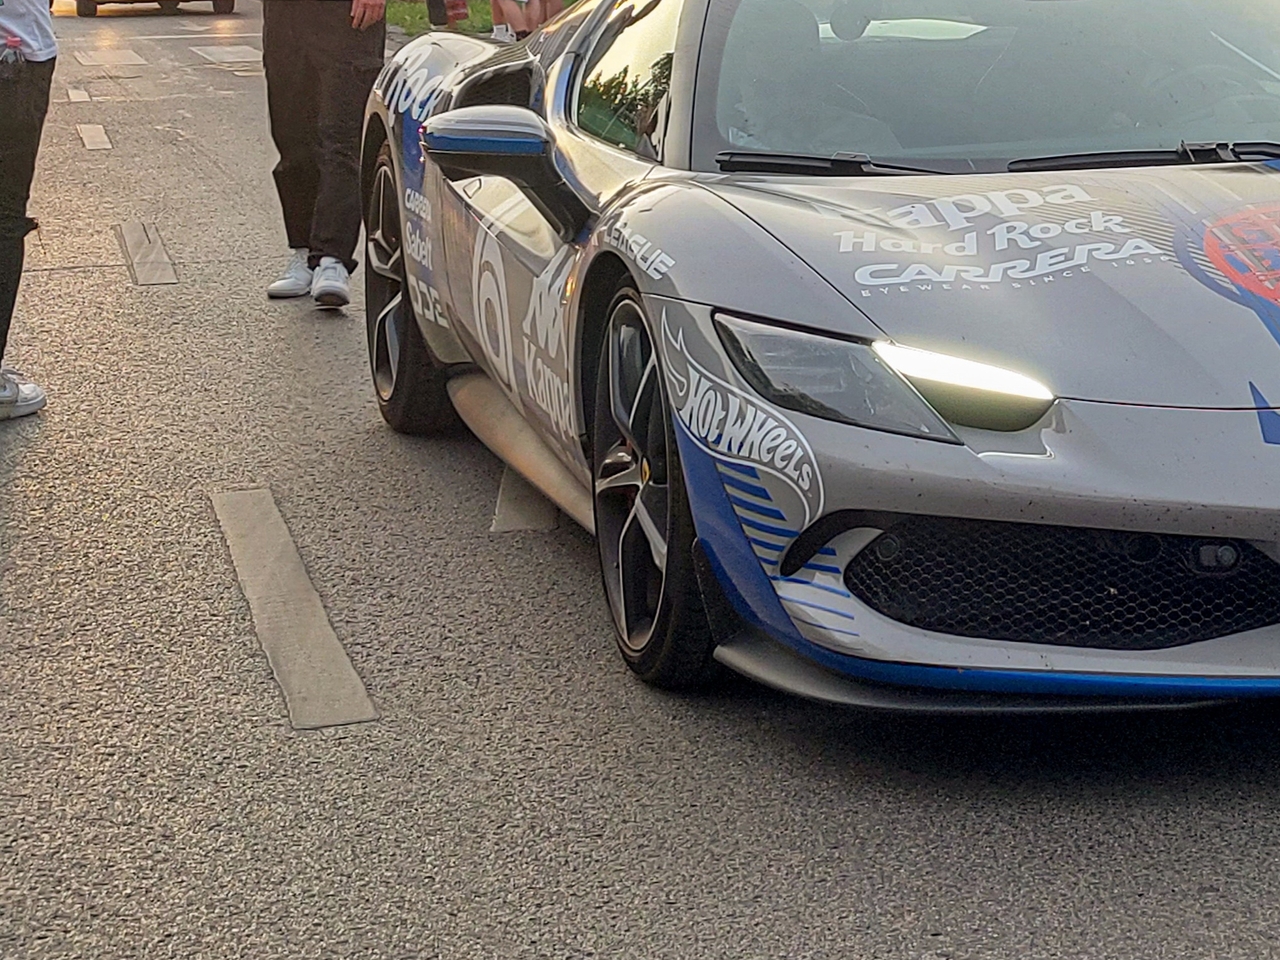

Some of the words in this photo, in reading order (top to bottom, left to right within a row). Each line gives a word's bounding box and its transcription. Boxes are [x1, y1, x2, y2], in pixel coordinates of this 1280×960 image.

[872, 183, 1099, 231] appa
[833, 231, 978, 256] Hard
[986, 210, 1132, 250] Rock
[853, 238, 1166, 285] CARRERA
[860, 283, 990, 297] EYEWEAR
[1011, 264, 1091, 289] SINCE
[522, 336, 578, 442] Kappa
